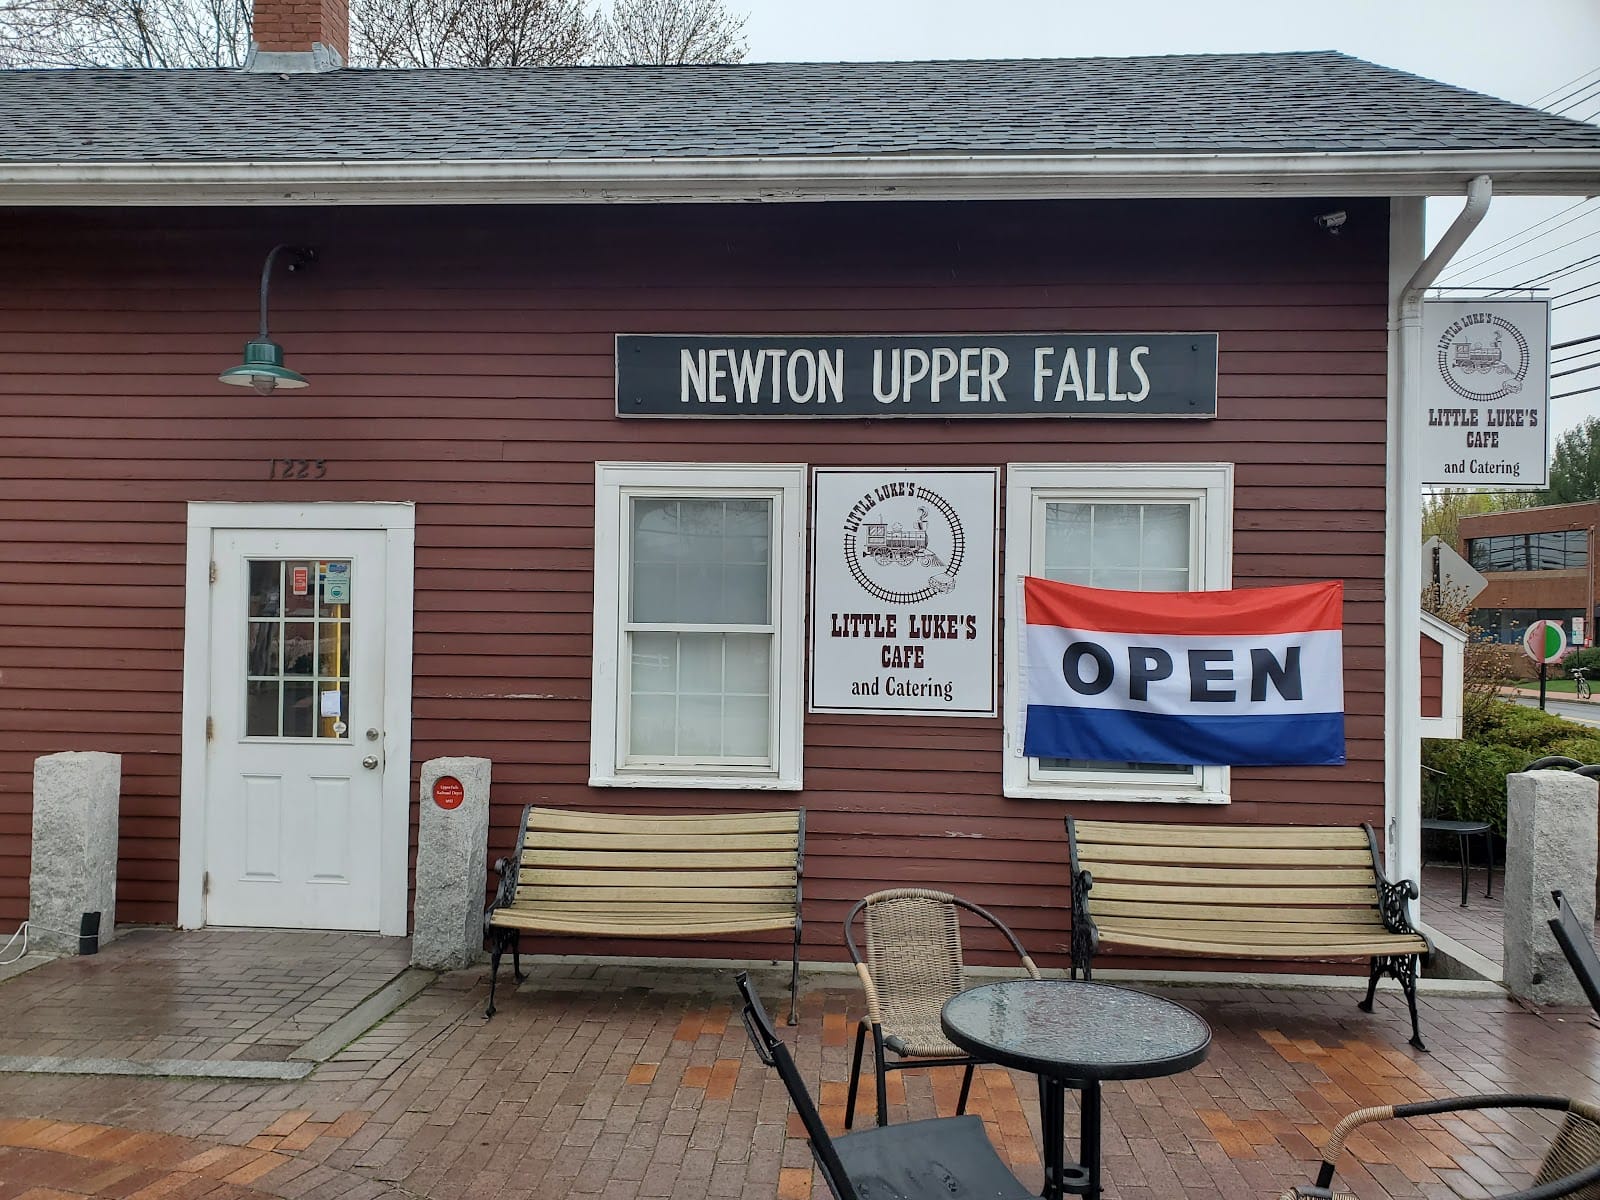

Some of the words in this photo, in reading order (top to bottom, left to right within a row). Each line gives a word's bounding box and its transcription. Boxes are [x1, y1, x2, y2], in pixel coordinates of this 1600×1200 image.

[1438, 321, 1463, 350] LITTLE
[1461, 312, 1493, 327] LUKE'S
[680, 348, 844, 404] NEWTON
[872, 347, 1009, 404] UPPER
[1033, 346, 1150, 403] FALLS
[1428, 408, 1479, 426] LITTLE
[1487, 408, 1538, 427] LUKE'S
[1466, 431, 1499, 448] CAFE
[269, 457, 328, 481] 1225
[1444, 459, 1465, 474] and
[1469, 459, 1520, 478] Catering
[843, 493, 877, 533] LITTLE
[874, 482, 916, 502] LUKE'S
[831, 613, 897, 638] LITTLE
[909, 614, 977, 640] LUKE'S
[881, 645, 925, 669] CAFE
[1062, 641, 1304, 702] OPEN
[851, 676, 880, 696] and
[885, 676, 953, 702] Catering
